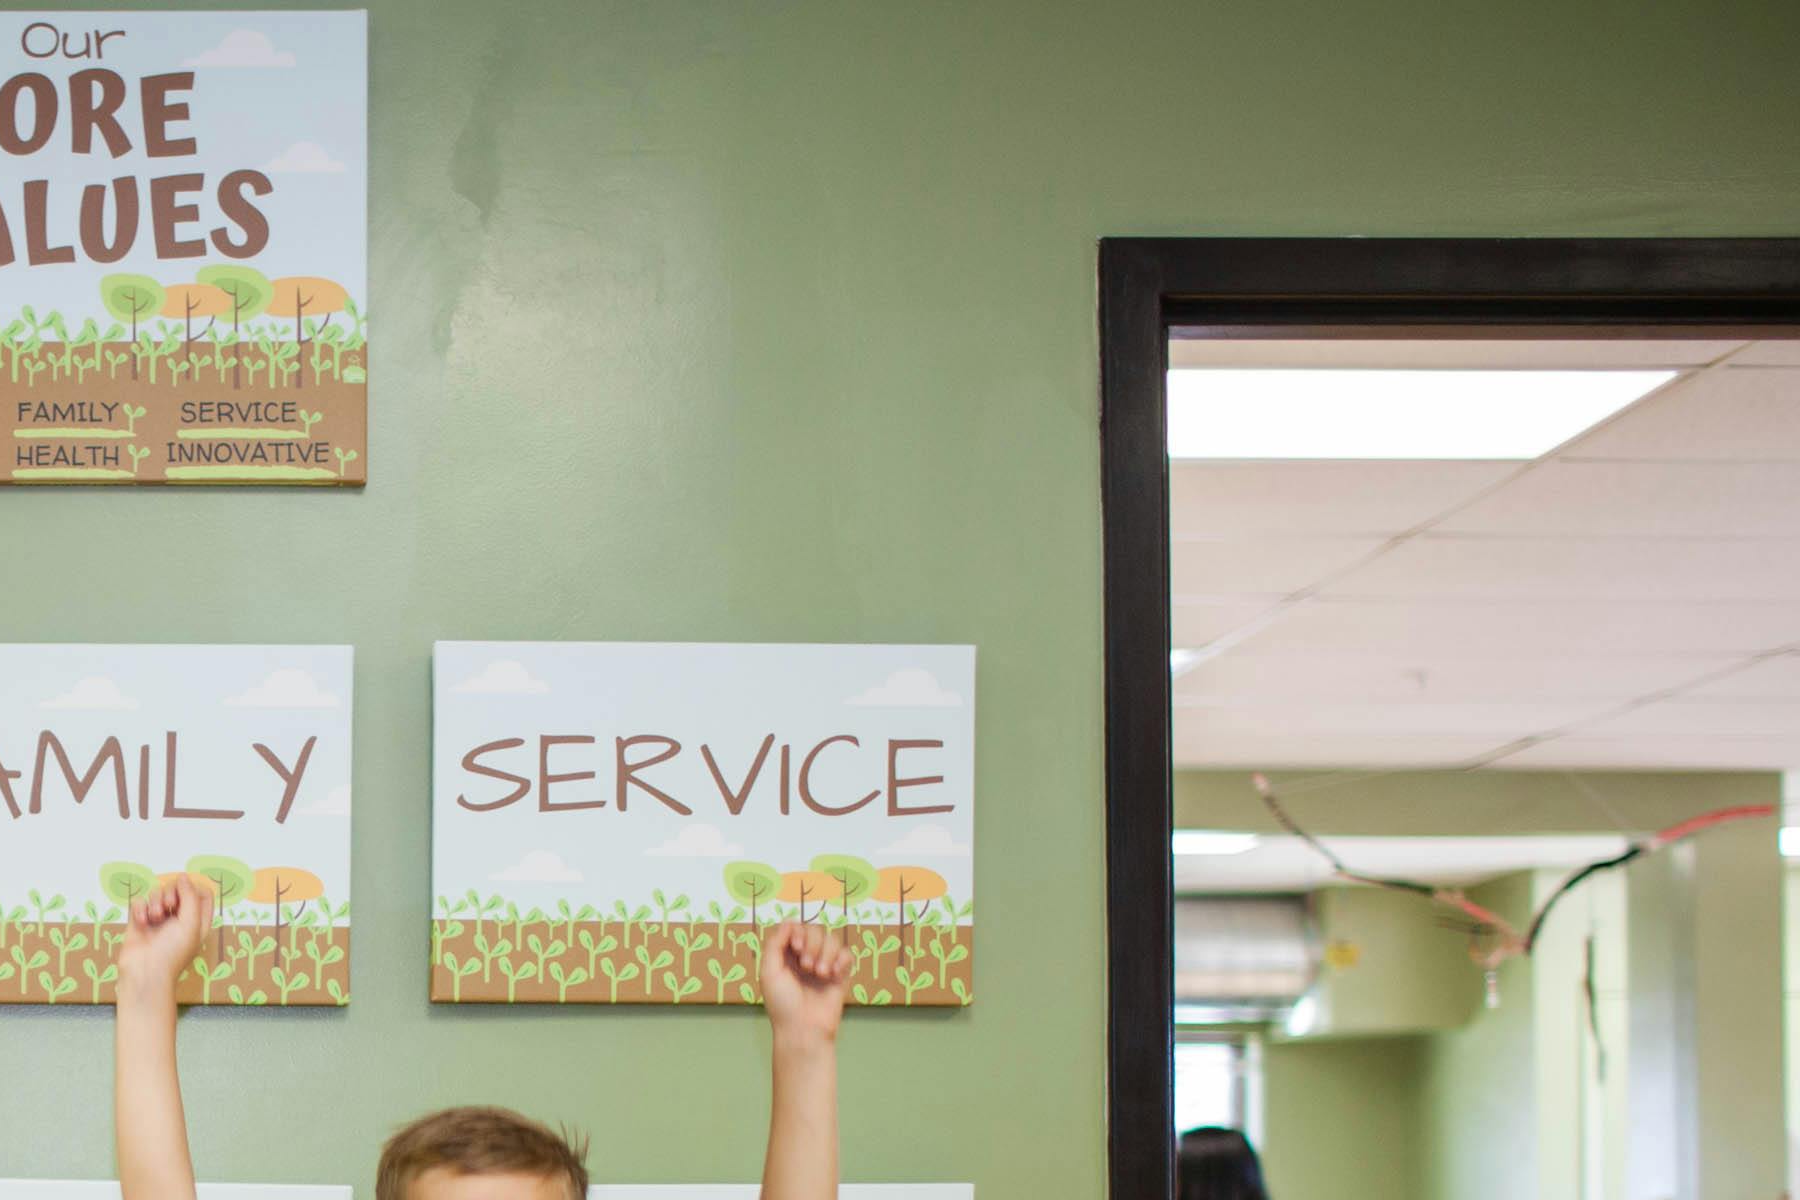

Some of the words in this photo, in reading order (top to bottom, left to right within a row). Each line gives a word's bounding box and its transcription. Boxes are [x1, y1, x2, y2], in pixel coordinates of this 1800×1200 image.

[21, 22, 126, 60] Our
[17, 401, 120, 424] FAMILY
[180, 401, 298, 425] SERVICE
[16, 444, 120, 467] HEALTH
[166, 441, 330, 465] INNOVATIVE
[456, 733, 956, 817] SERVICE
